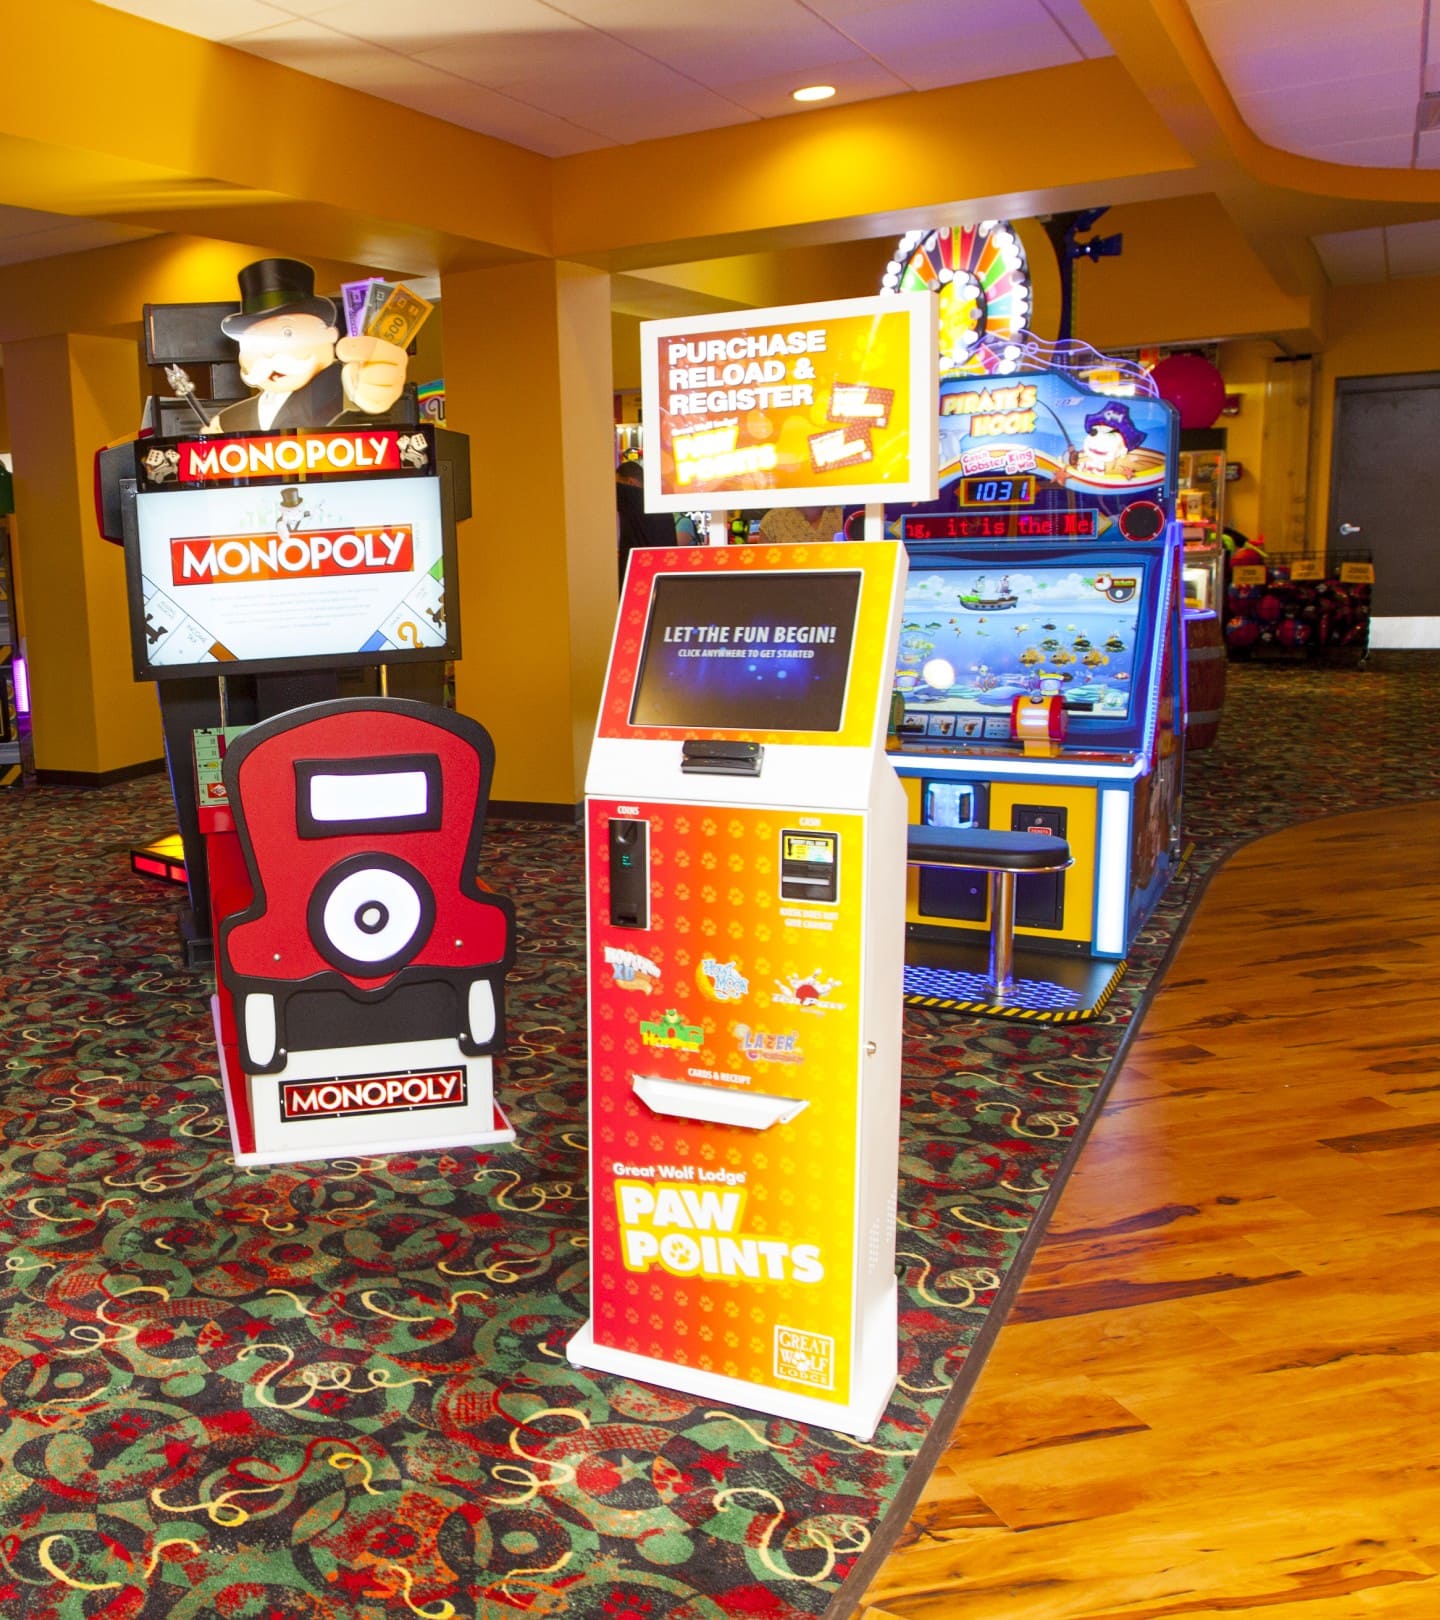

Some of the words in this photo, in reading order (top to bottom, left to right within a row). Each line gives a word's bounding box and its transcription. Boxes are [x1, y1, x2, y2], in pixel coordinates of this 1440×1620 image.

[668, 329, 827, 365] PURCHASE
[669, 360, 786, 391] RELOAD
[793, 357, 816, 380] &
[669, 383, 813, 416] REGISTER
[189, 437, 389, 476] MONOPOLY
[976, 481, 1028, 501] 1031
[948, 517, 968, 536] it
[982, 517, 1005, 536] is
[1017, 515, 1053, 536] the
[1064, 513, 1093, 536] Me
[182, 531, 406, 578] MONOPOLY
[663, 626, 693, 643] LET
[696, 626, 730, 643] THE
[733, 626, 770, 643] FUN
[773, 626, 837, 643] BEGIN!
[678, 649, 700, 658] CLICK
[701, 649, 746, 658] ANYWHERE
[748, 649, 759, 658] TO
[760, 649, 777, 658] GET
[777, 649, 815, 658] STARTED
[744, 1030, 795, 1051] LAZER
[291, 1076, 458, 1113] MONOPOLY
[613, 1162, 655, 1178] Great
[657, 1165, 694, 1181] Wolf
[698, 1167, 746, 1186] Lodge
[620, 1185, 741, 1232] PAW
[625, 1230, 825, 1283] POINTS
[779, 1331, 830, 1355] GREAT
